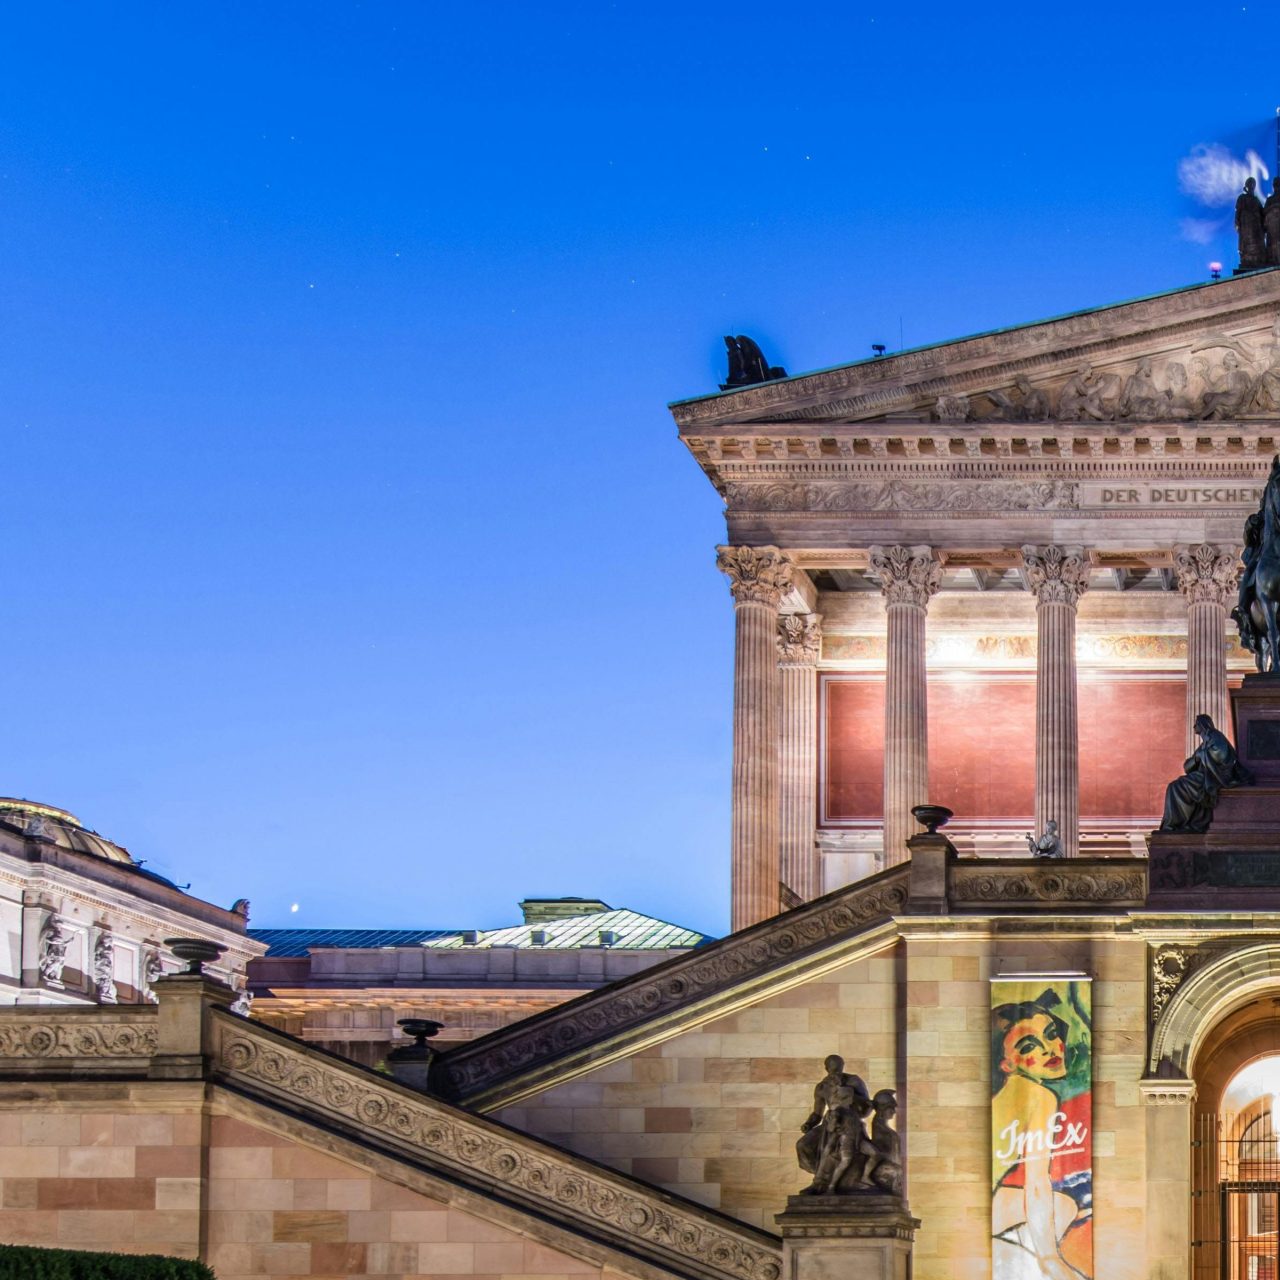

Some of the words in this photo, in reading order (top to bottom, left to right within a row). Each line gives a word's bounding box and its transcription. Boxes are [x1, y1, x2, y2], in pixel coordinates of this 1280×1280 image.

[1103, 489, 1139, 502] DER
[1152, 488, 1262, 502] DEUTSCHEN
[996, 1111, 1088, 1159] ImEx
